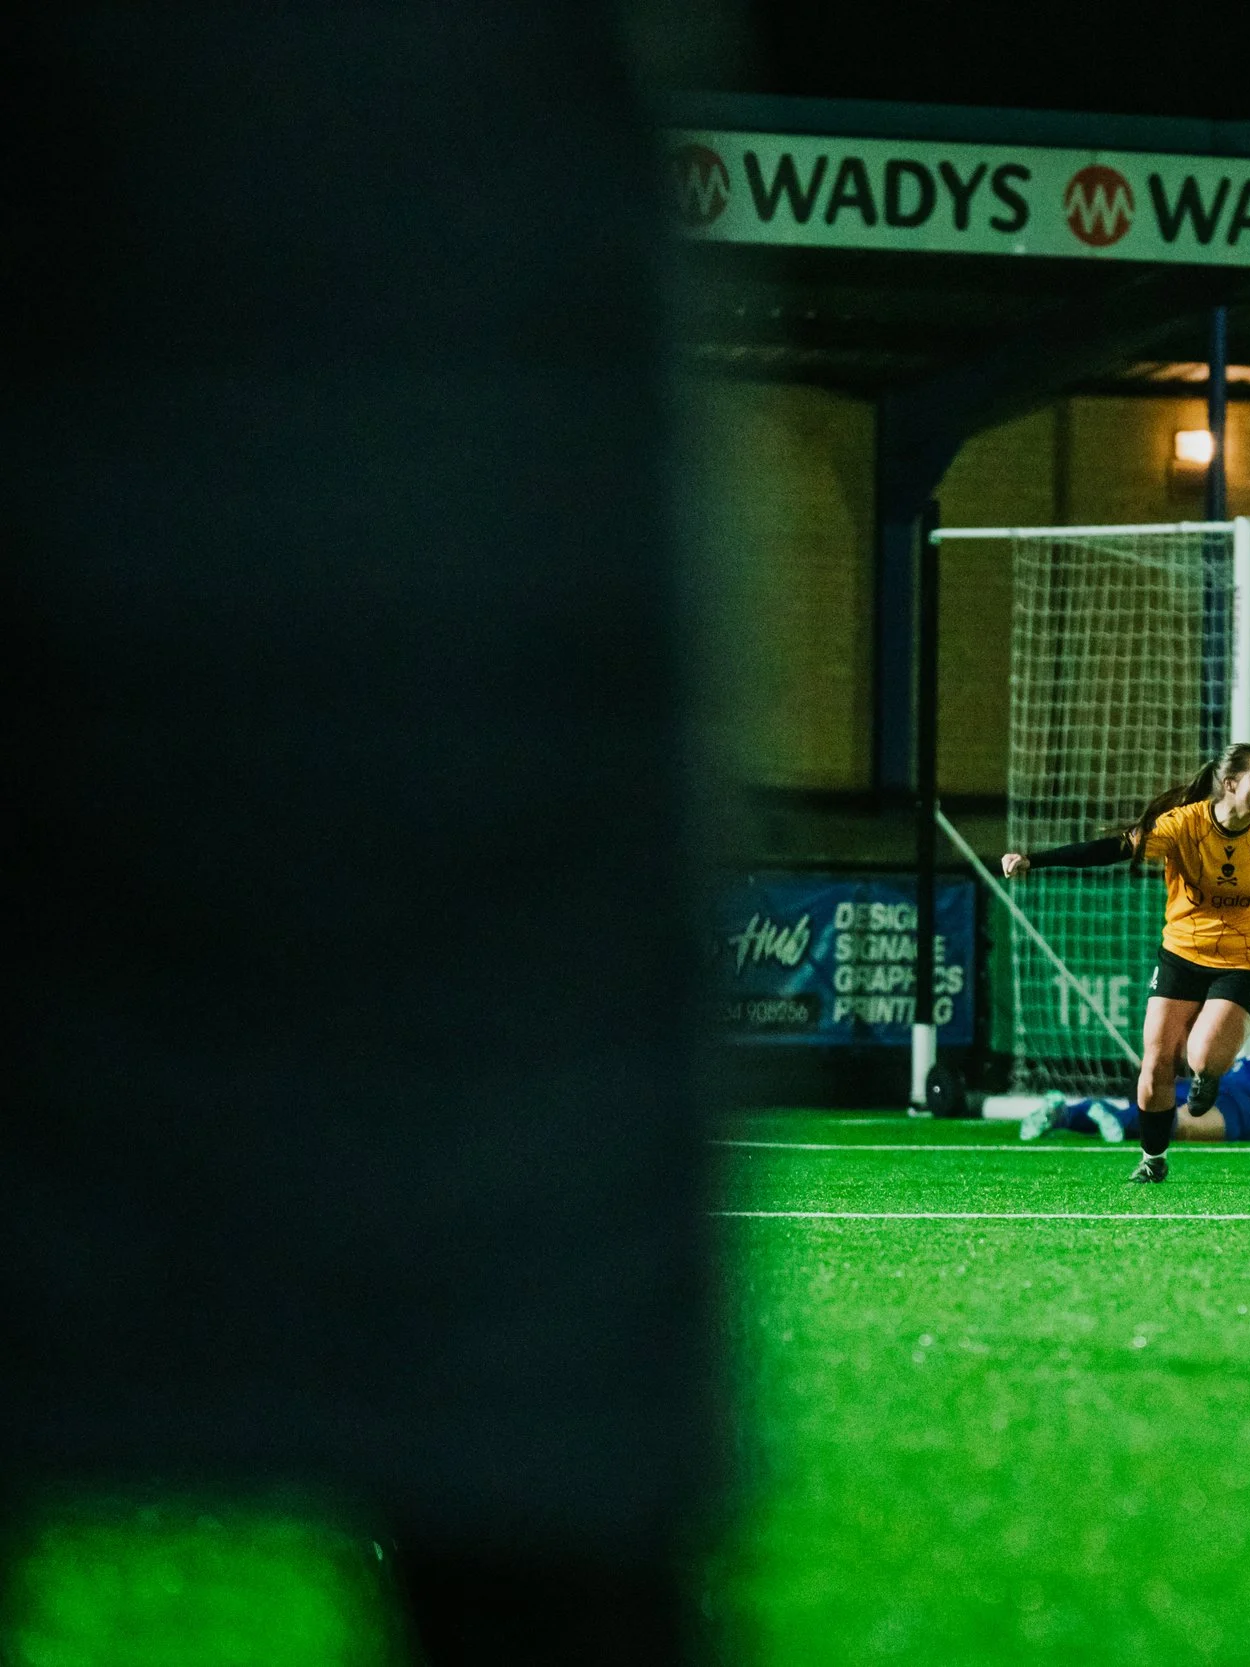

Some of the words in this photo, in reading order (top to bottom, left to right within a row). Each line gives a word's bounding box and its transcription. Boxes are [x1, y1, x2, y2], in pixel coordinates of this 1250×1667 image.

[743, 150, 1032, 233] WADYS
[835, 933, 946, 962] SIGNAE
[834, 965, 963, 994] GRAPHCS
[832, 996, 953, 1025] PRINTIG
[1053, 974, 1129, 1027] THE
